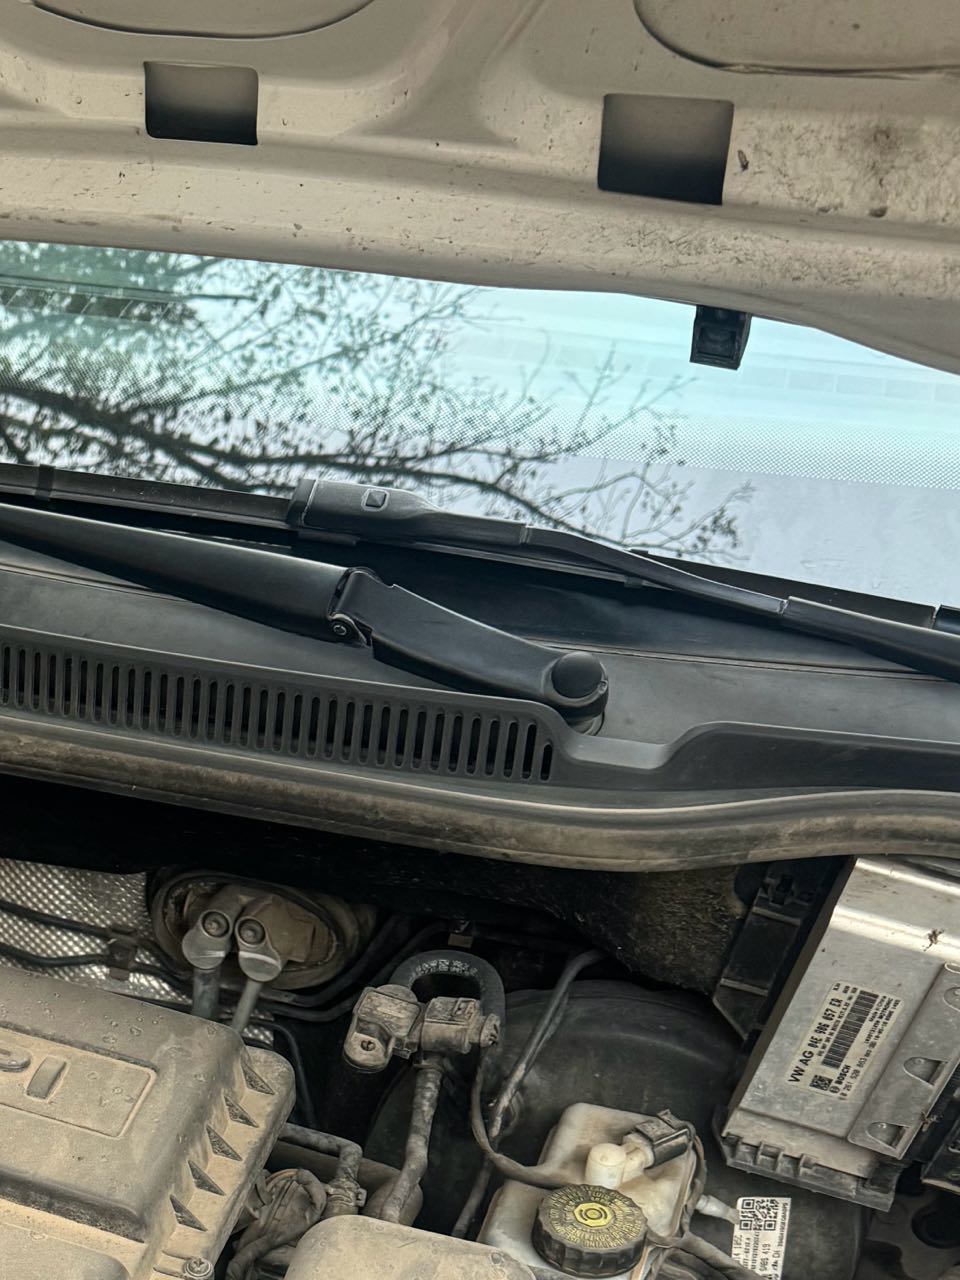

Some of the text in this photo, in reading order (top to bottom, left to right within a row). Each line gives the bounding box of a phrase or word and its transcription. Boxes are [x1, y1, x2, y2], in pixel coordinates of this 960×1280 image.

[788, 1066, 805, 1083] VW
[797, 1049, 814, 1065] AG
[833, 1064, 851, 1085] BOSCH
